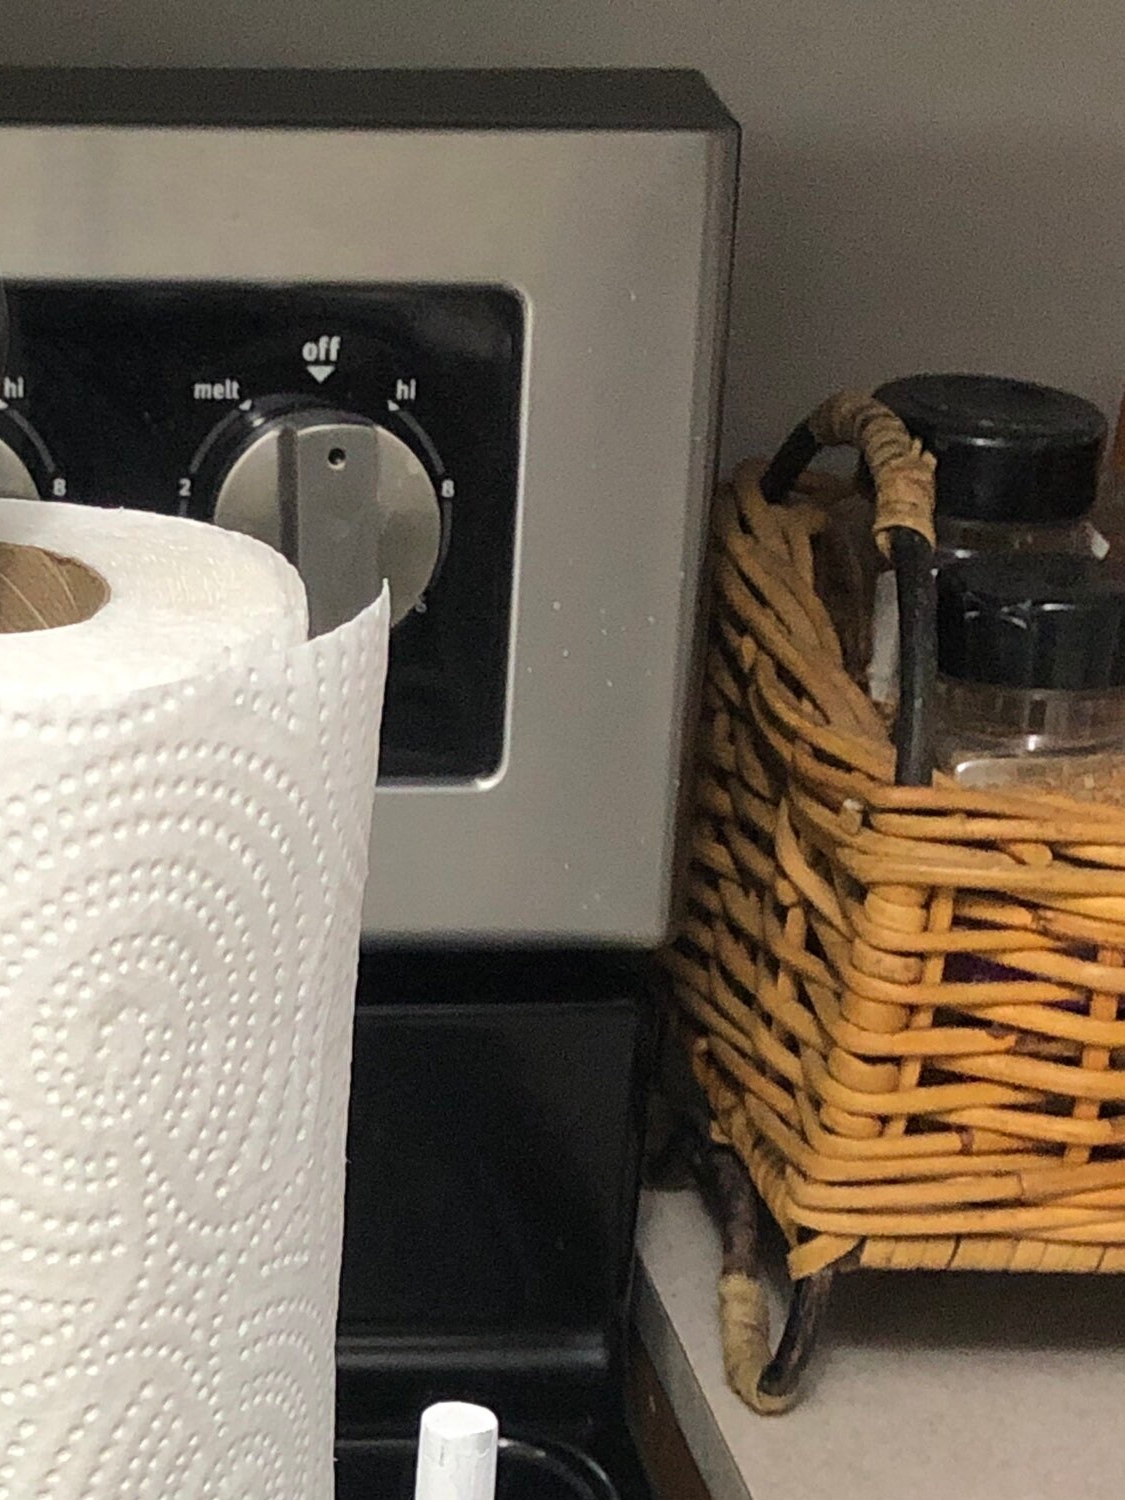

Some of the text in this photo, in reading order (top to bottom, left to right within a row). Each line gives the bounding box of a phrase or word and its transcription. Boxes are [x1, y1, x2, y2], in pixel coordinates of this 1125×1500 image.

[302, 336, 341, 361] off
[3, 376, 25, 398] hi
[193, 378, 240, 400] melt
[396, 378, 416, 400] hi
[52, 478, 67, 497] 8
[179, 478, 192, 497] 2
[441, 479, 454, 498] 8
